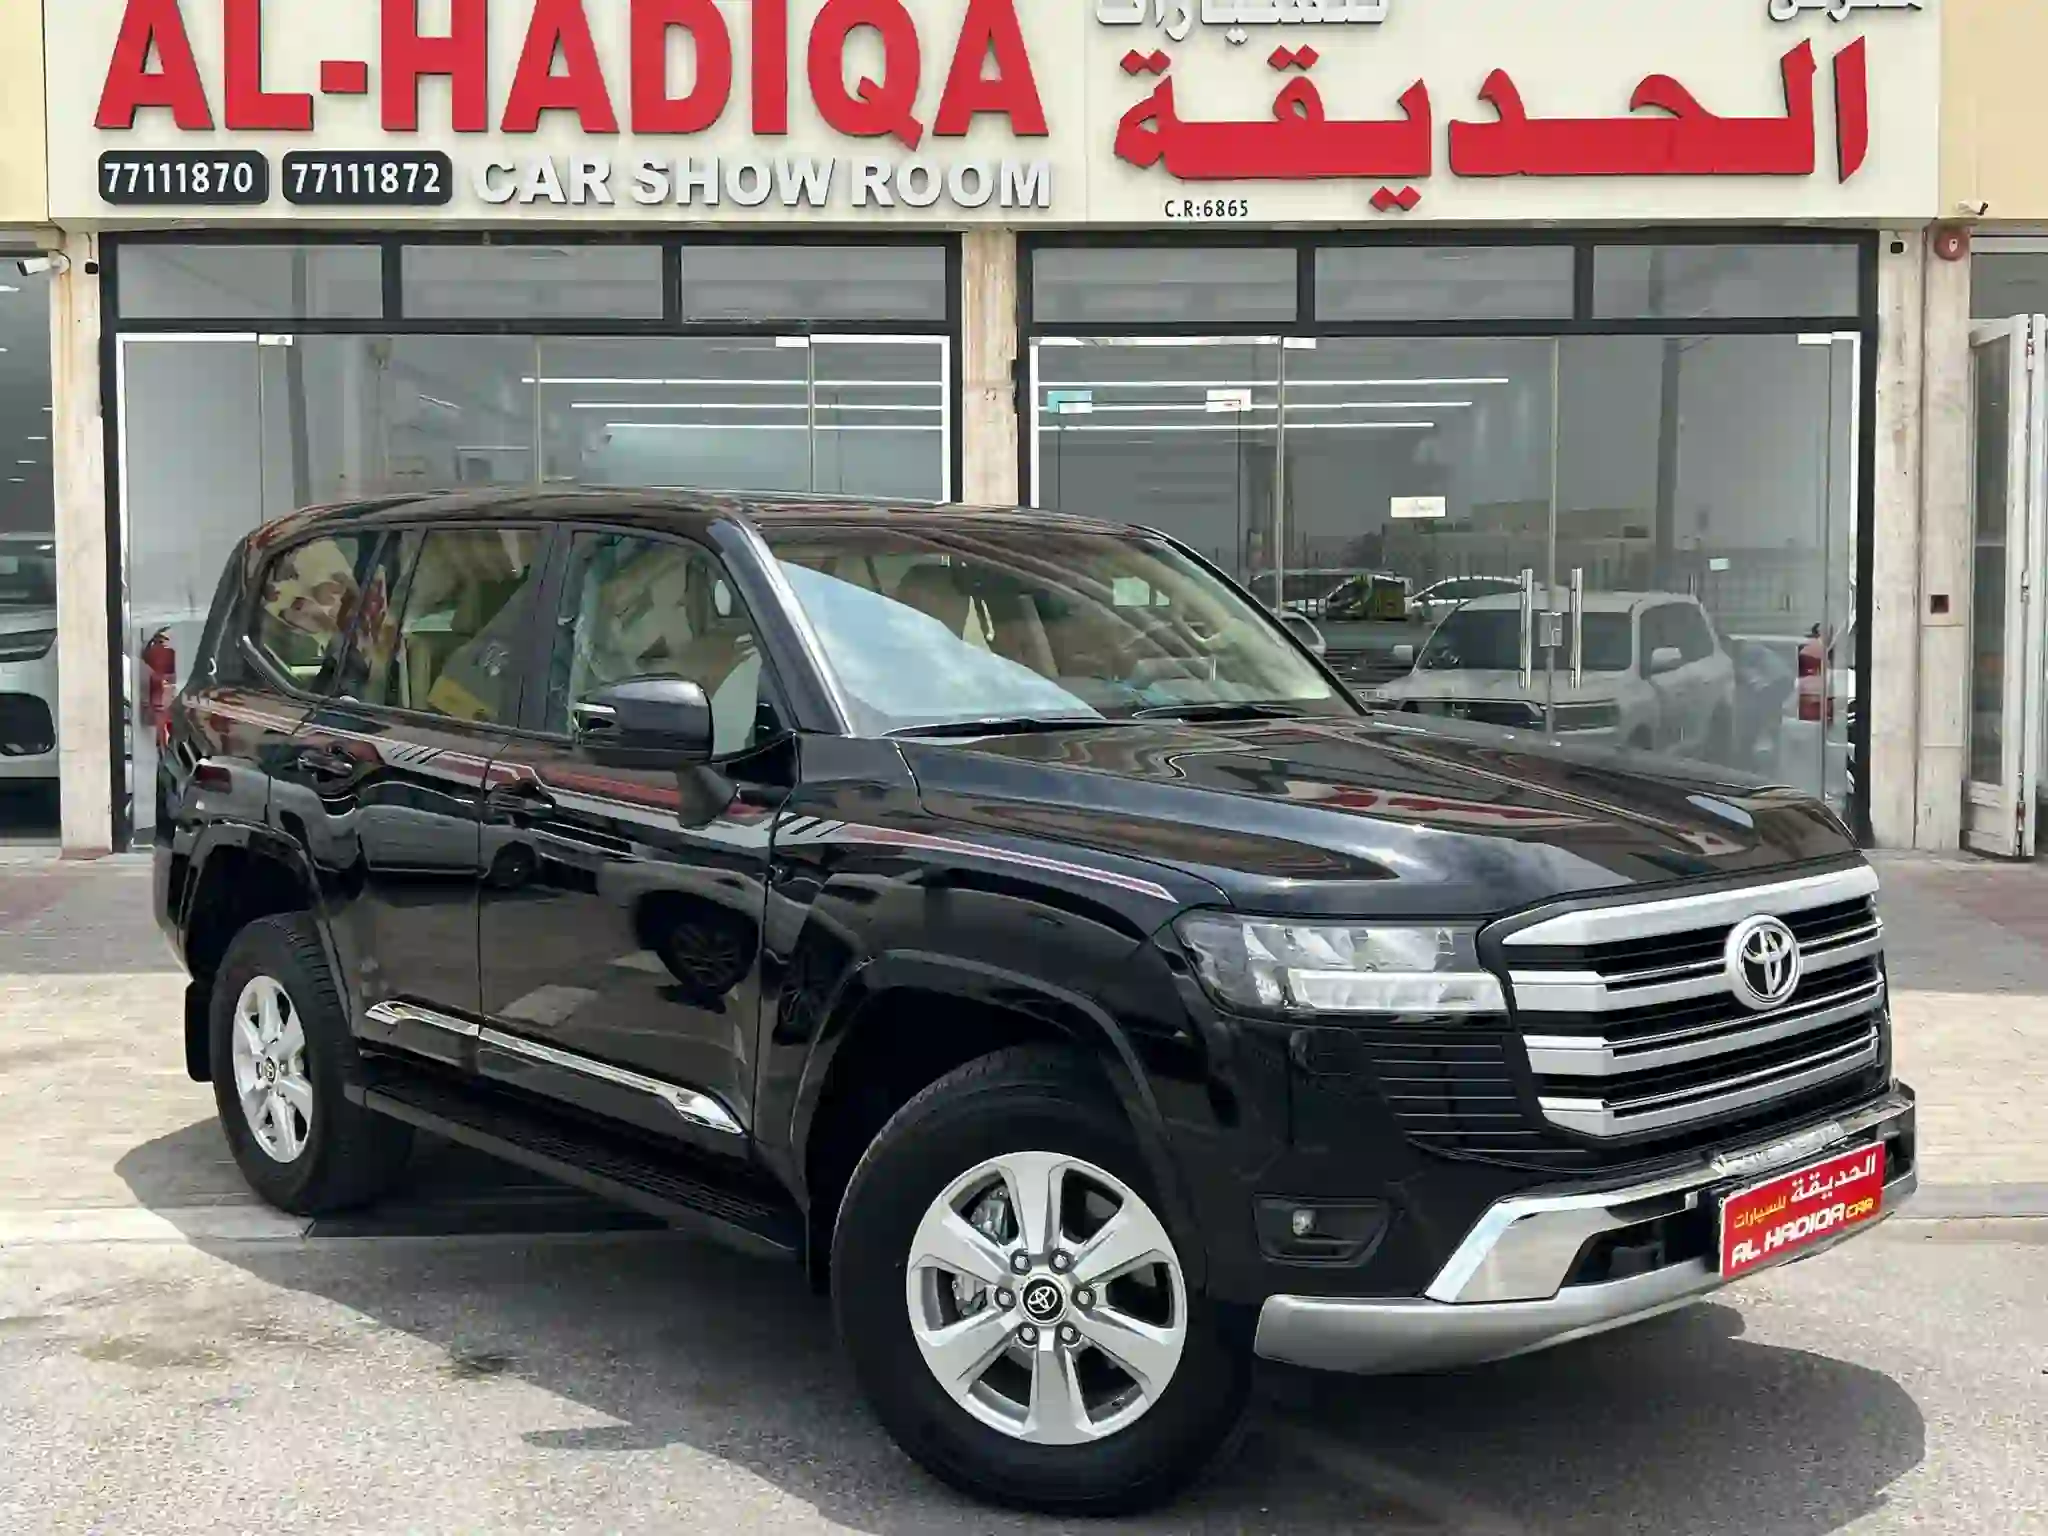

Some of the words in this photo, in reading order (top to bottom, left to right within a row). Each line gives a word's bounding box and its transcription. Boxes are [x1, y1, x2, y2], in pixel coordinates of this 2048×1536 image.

[95, 0, 1050, 151] AL-HADIQA
[1114, 36, 1870, 212] الحديقة
[104, 161, 255, 195] 77111870
[290, 161, 442, 195] 77111872
[476, 157, 616, 206] CAR
[632, 158, 836, 208] SHOW
[851, 158, 1052, 209] ROOM
[1164, 199, 1250, 219] C.R:6865
[1790, 1152, 1876, 1203] الحديقة
[1733, 1194, 1787, 1229] للسيارات
[1731, 1239, 1761, 1268] AL
